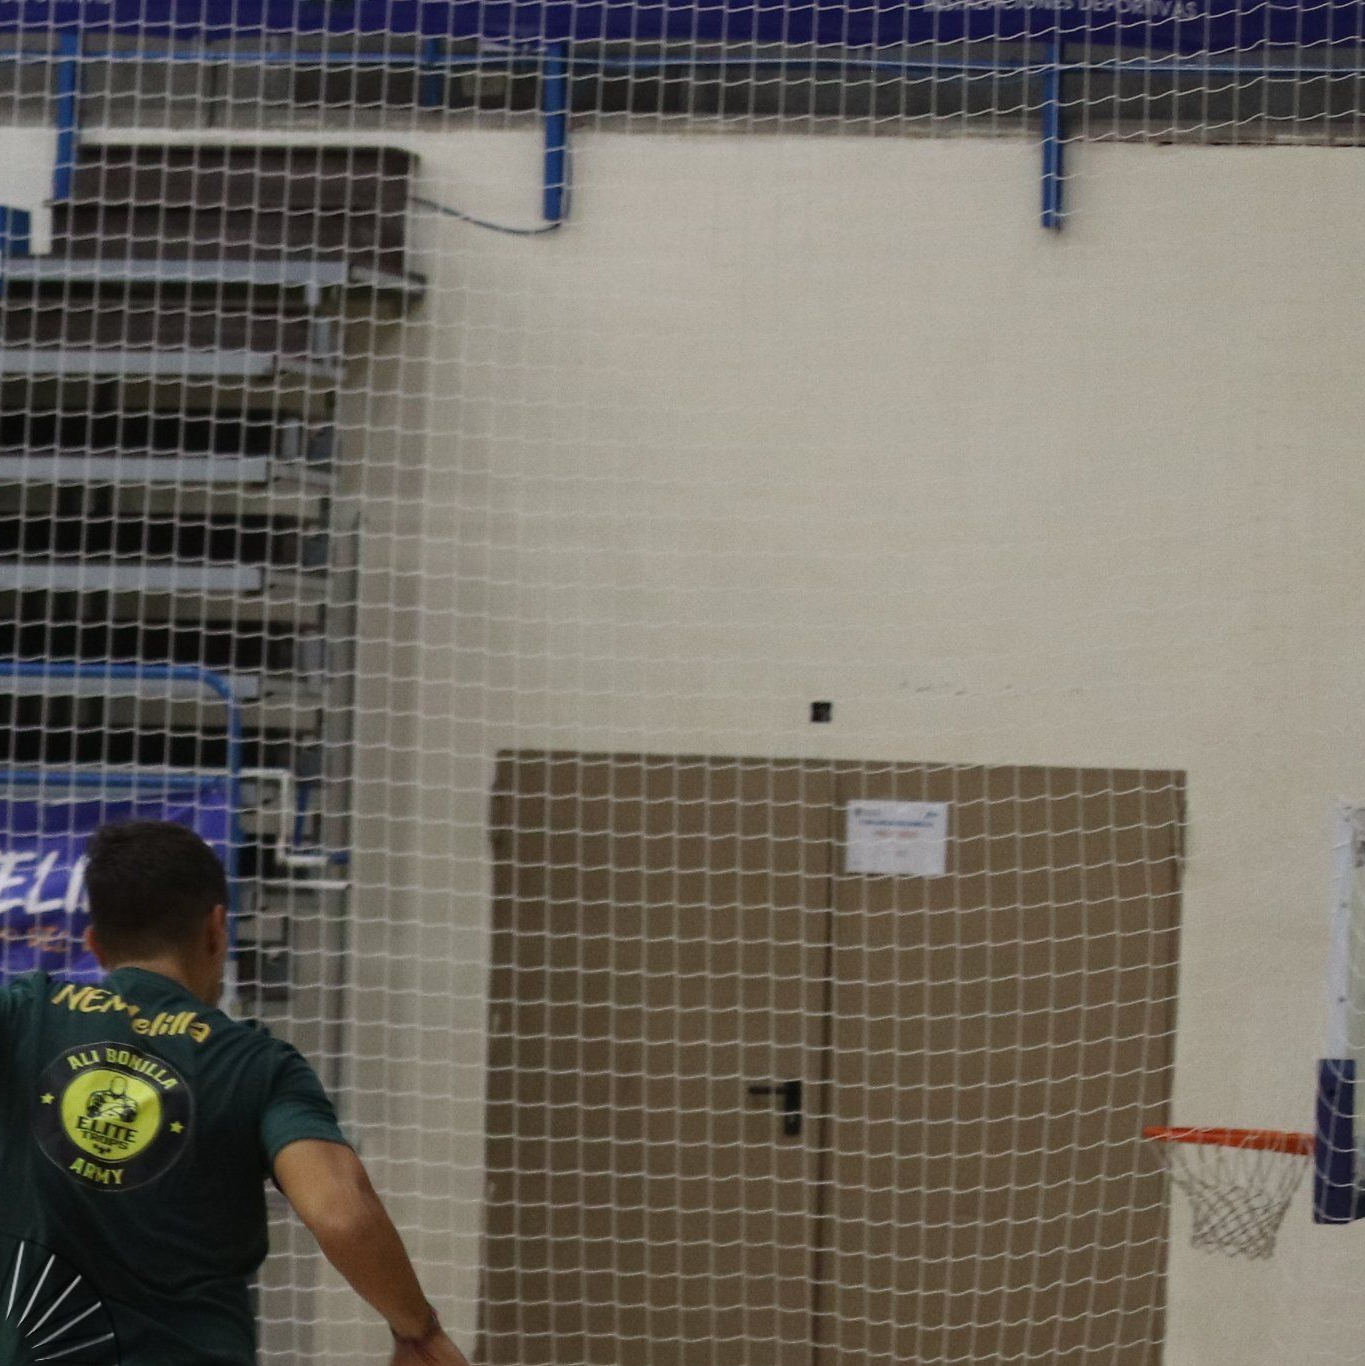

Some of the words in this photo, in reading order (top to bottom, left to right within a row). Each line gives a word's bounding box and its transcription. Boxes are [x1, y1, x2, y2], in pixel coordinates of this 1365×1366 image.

[67, 1049, 101, 1070] ALI
[105, 1048, 178, 1090] BONILLA
[75, 1116, 138, 1144] ELITE
[69, 1157, 125, 1184] ARMY
